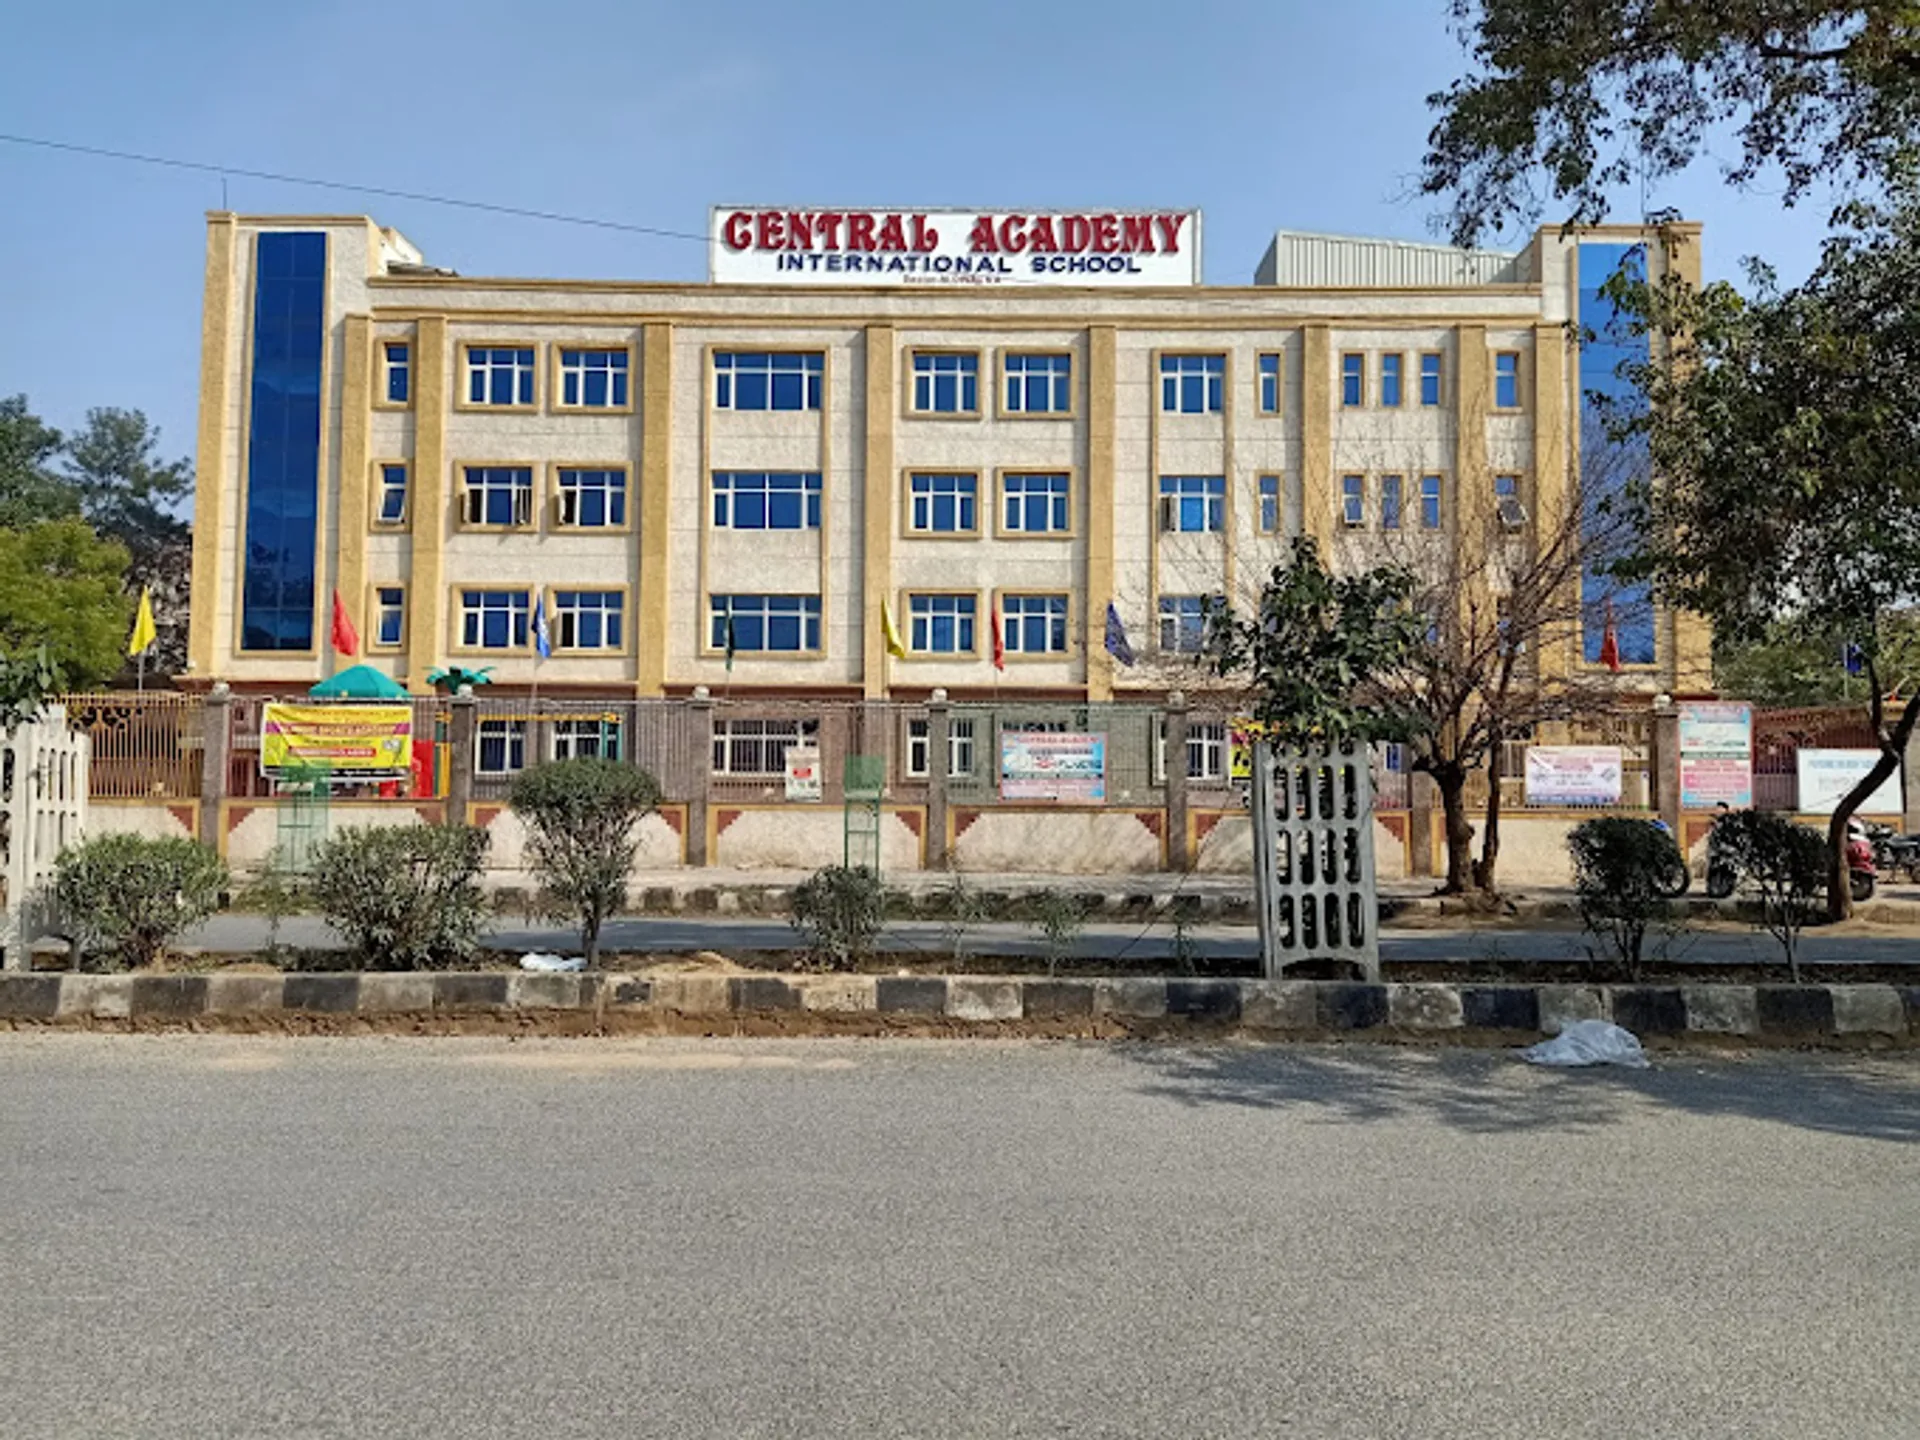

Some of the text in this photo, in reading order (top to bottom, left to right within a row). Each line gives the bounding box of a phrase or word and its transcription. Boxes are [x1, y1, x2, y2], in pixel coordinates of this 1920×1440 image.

[725, 211, 1187, 253] CENTRAL ACADEMY
[777, 253, 1142, 273] INTERNATIONAL SCHOOL
